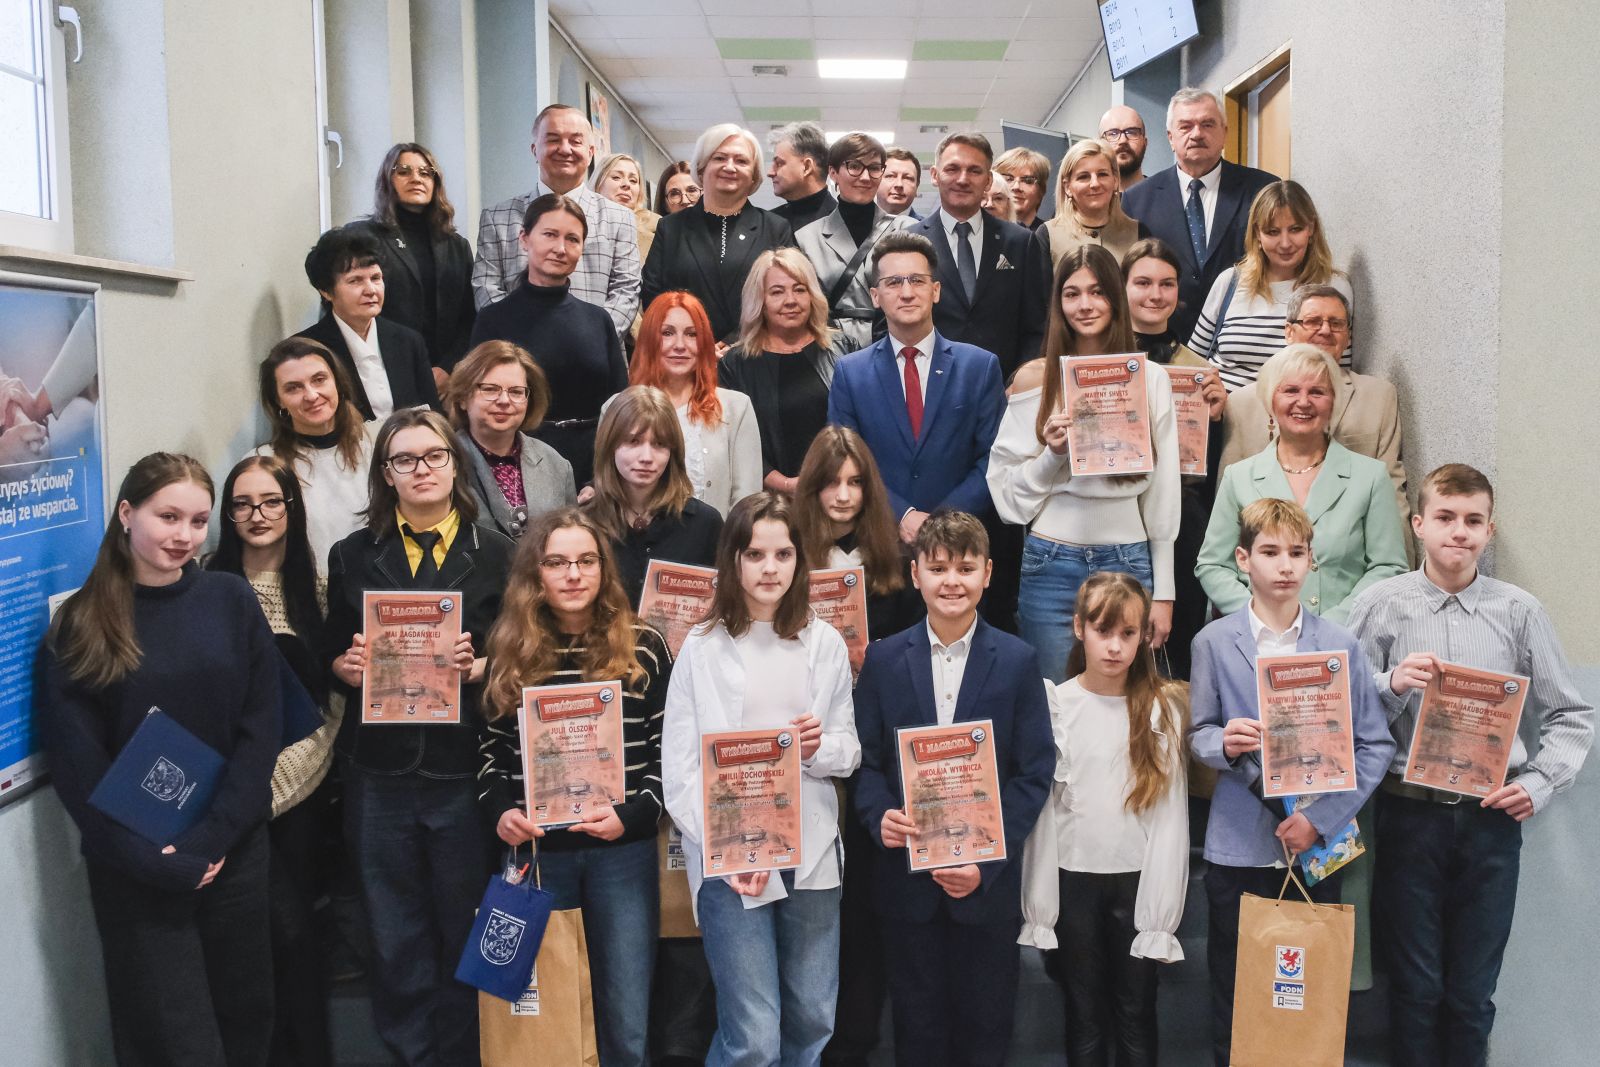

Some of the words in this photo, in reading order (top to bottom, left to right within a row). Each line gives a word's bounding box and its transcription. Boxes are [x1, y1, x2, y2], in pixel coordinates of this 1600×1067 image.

[0, 480, 28, 502] ryzys
[31, 469, 73, 496] życiowy?
[0, 503, 16, 528] taj
[18, 505, 30, 521] ze
[32, 493, 78, 521] wsparcia.
[949, 763, 983, 774] WYRWICZA
[1280, 986, 1303, 994] PODN
